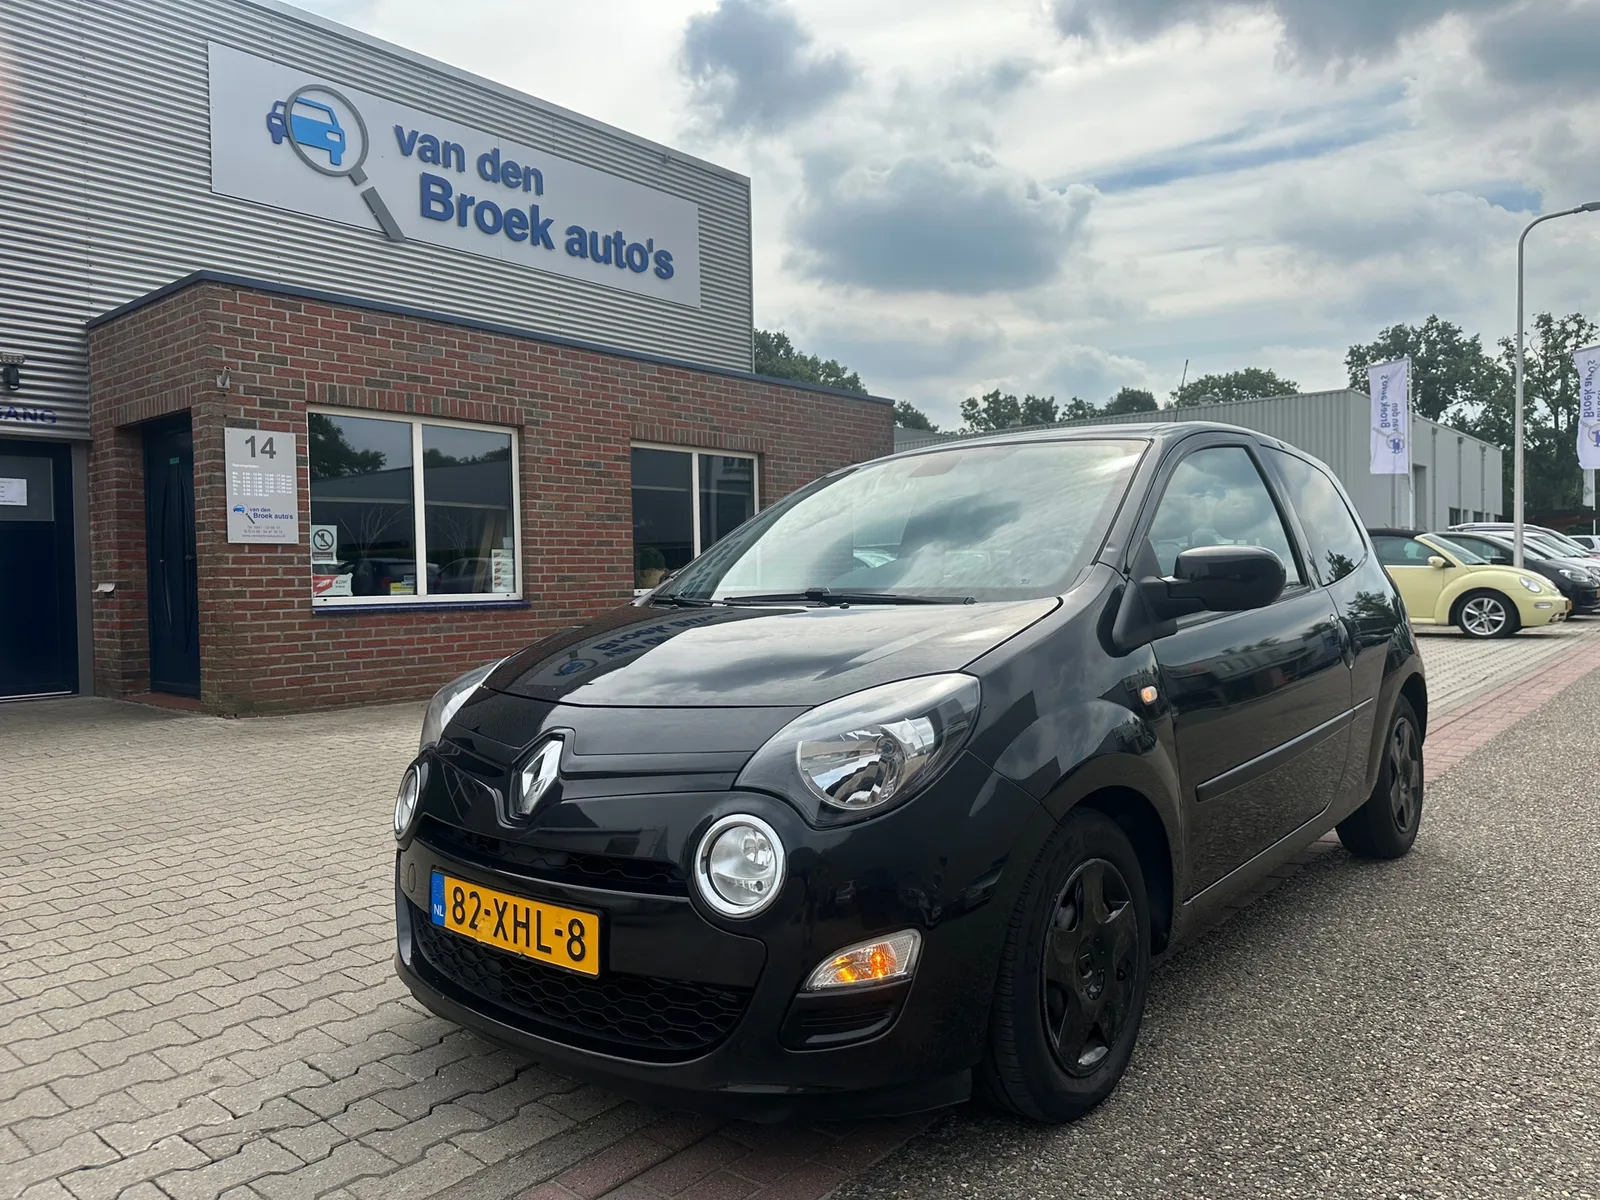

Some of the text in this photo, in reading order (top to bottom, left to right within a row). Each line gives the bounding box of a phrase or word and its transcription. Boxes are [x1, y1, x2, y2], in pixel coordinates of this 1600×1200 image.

[393, 124, 544, 196] van den
[420, 172, 675, 280] Broek auto's
[0, 406, 57, 424] ANG
[245, 435, 276, 459] 14
[433, 903, 444, 917] NL
[452, 886, 586, 962] 82-XHL-8
